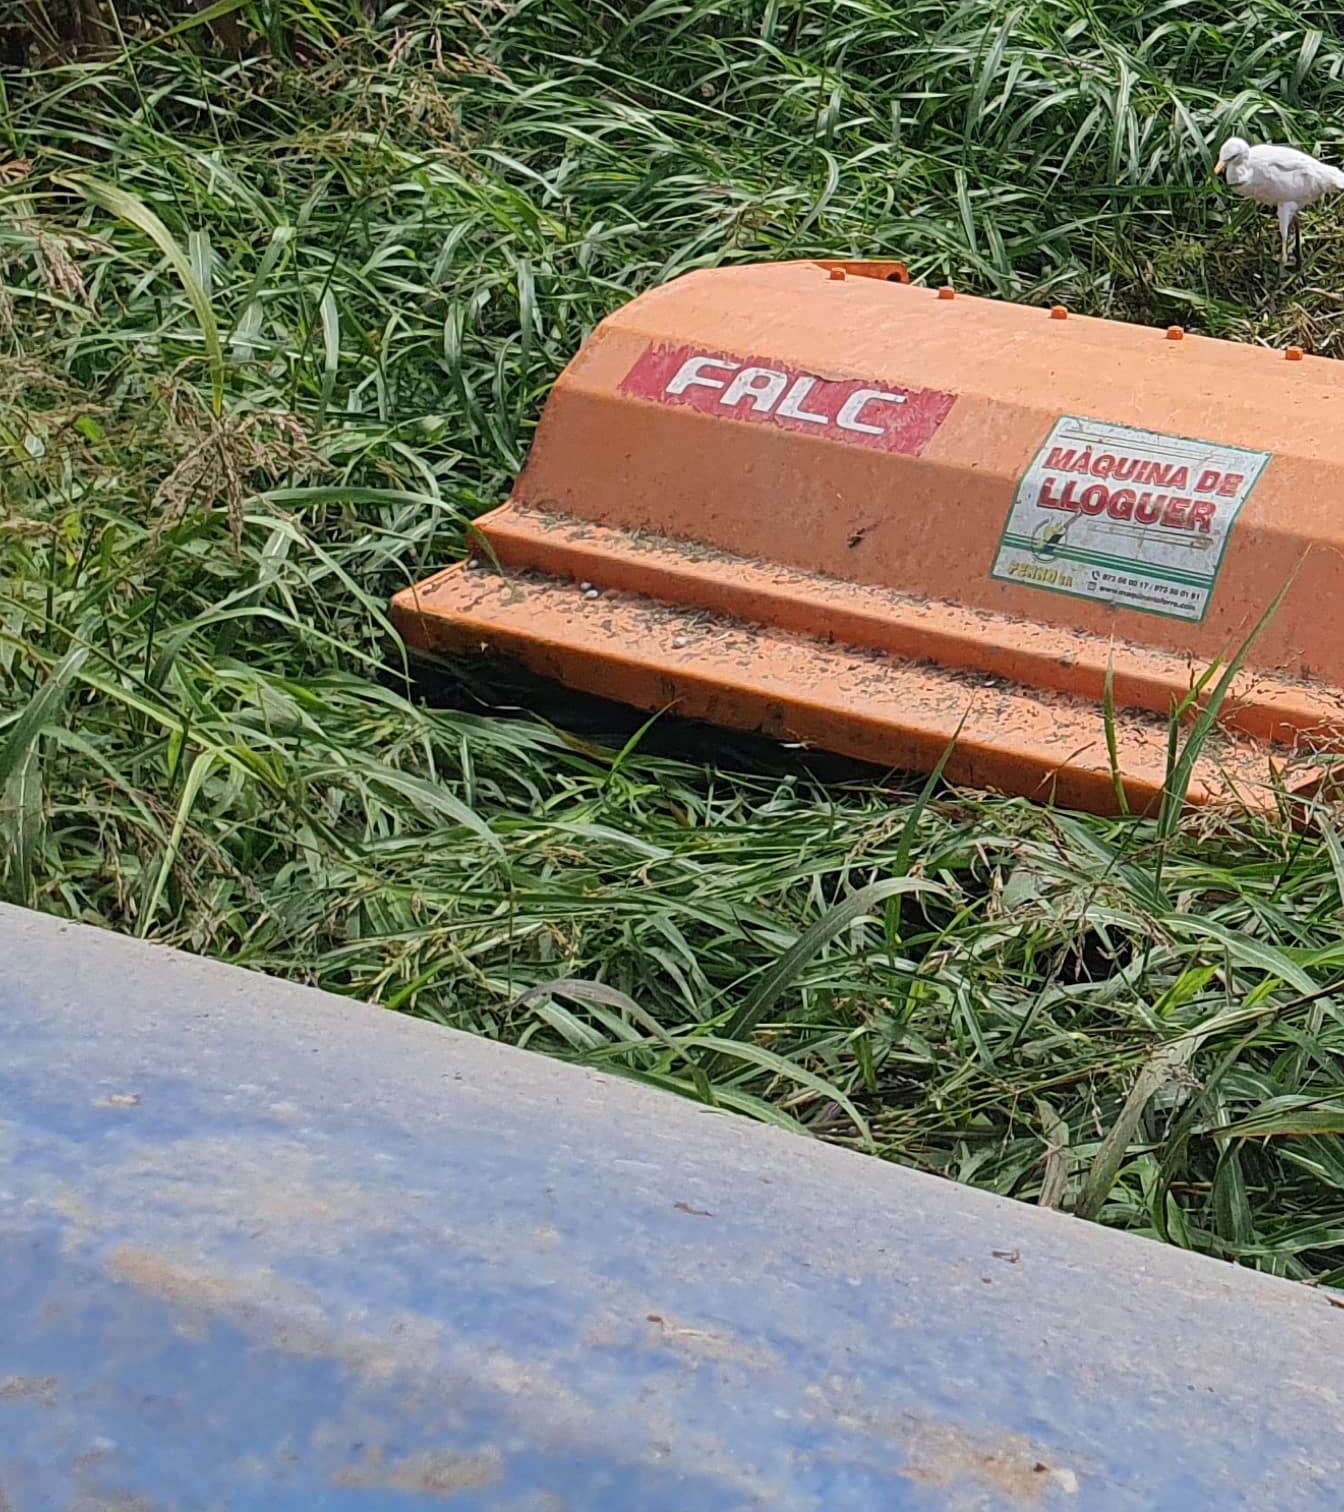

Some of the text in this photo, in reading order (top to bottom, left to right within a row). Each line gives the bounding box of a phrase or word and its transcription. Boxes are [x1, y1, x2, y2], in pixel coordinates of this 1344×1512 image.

[665, 355, 907, 436] FALC
[1043, 445, 1244, 497] MÀQUINA DE
[1037, 477, 1217, 533] LLOGUER
